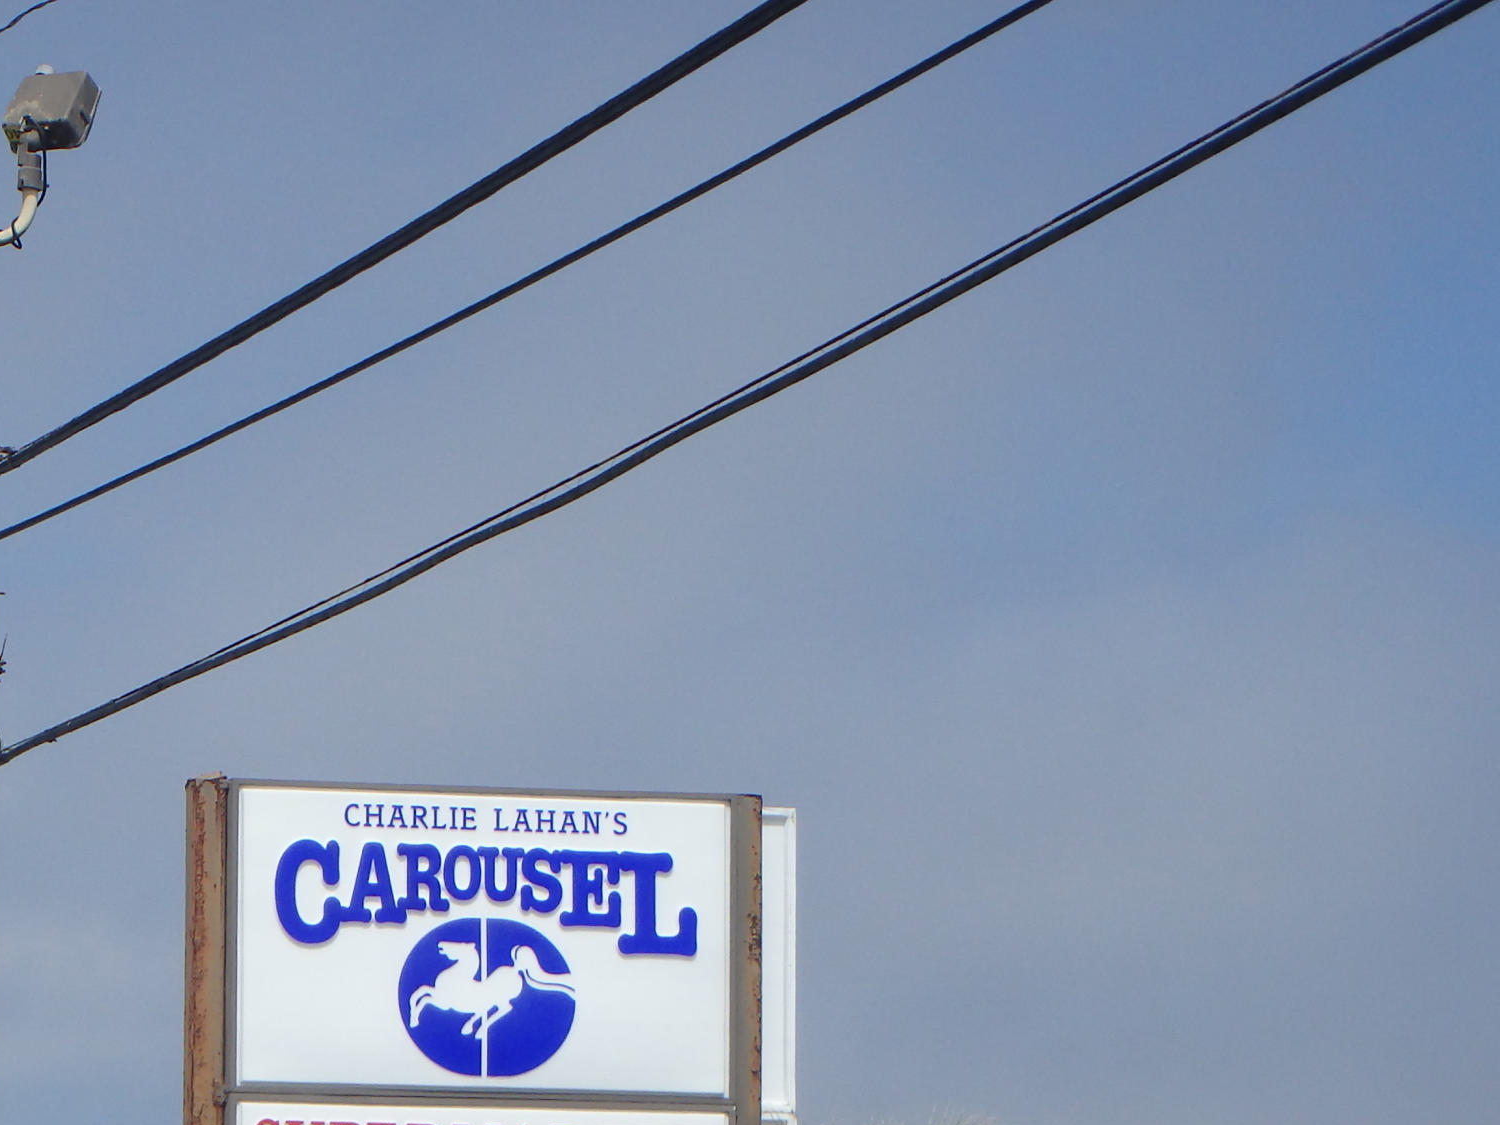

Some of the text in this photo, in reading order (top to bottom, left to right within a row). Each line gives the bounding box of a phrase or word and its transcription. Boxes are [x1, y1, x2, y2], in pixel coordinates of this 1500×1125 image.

[346, 801, 629, 836] CHARLIE LAHAN'S
[274, 838, 699, 956] CAROUSEL
